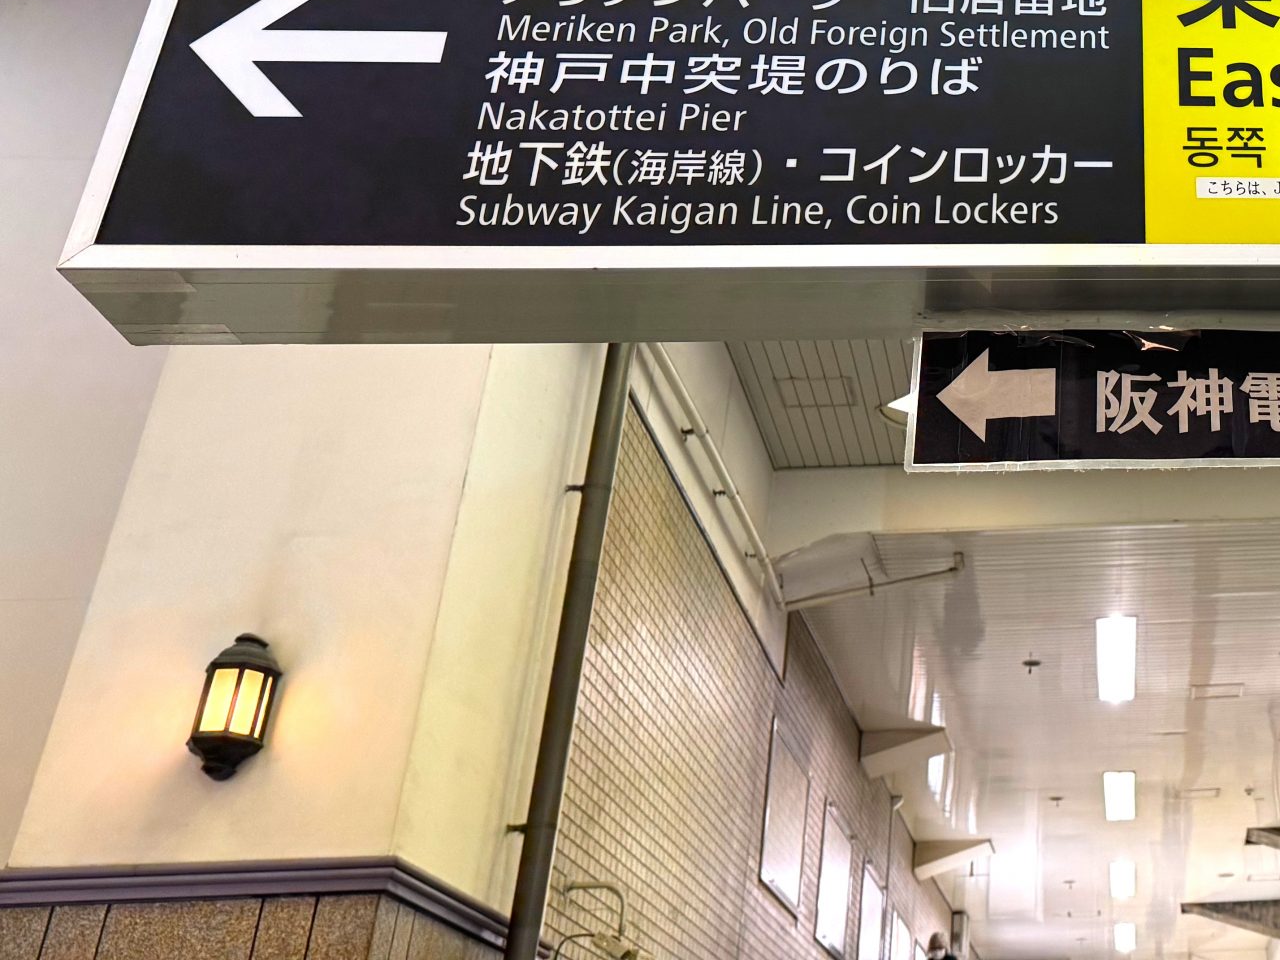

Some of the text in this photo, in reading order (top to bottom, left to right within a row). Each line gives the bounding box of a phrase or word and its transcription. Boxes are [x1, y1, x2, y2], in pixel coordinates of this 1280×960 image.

[498, 14, 1109, 53] Meriken Park, Old Foreign Settlement
[485, 51, 982, 95] 神戸中突堤のりば
[478, 101, 747, 131] Nakatottei Pier
[1183, 127, 1266, 168] 동쪽
[456, 193, 1058, 234] Subway Kaigan Line, Coin Lockers
